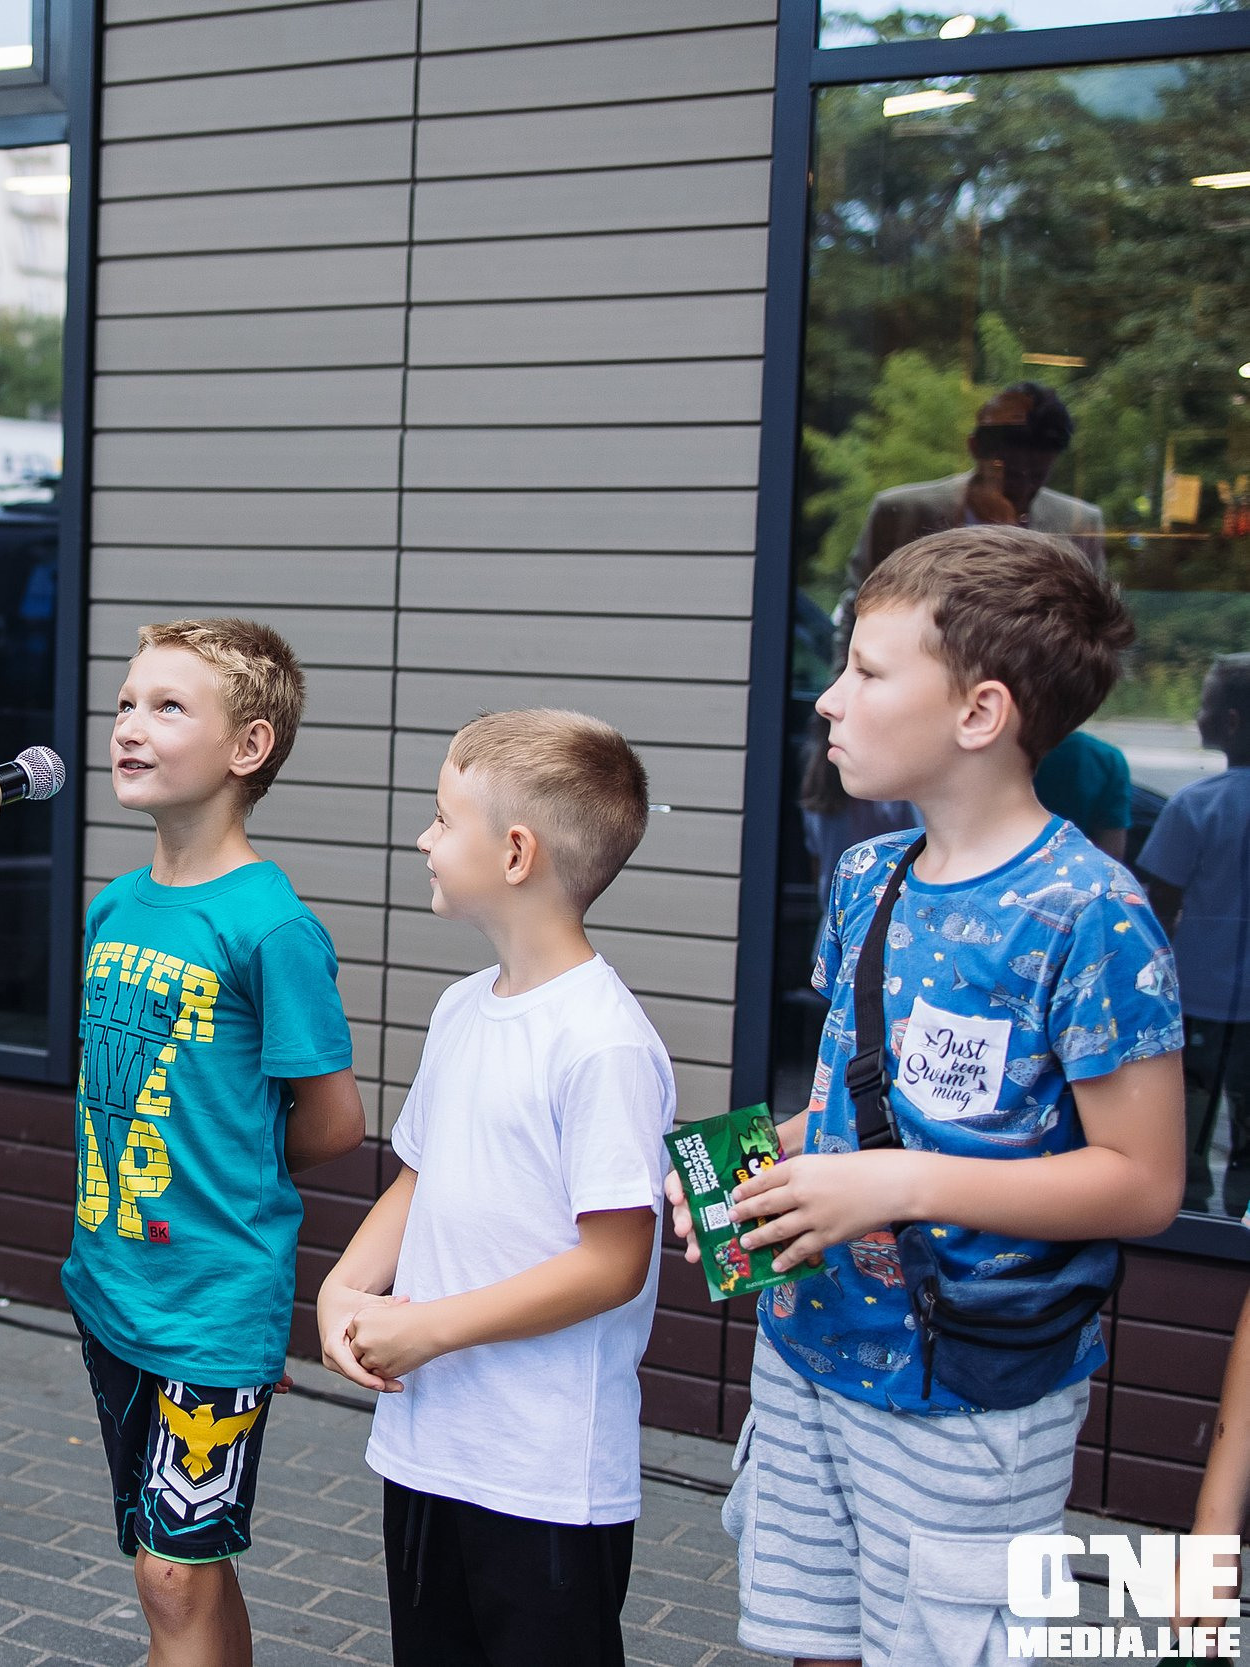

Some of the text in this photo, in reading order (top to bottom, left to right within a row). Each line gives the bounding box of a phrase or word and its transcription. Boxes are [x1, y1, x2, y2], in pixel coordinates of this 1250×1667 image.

[936, 1028, 990, 1060] Just
[903, 1052, 968, 1086] Swim
[950, 1057, 988, 1080] keep
[931, 1085, 973, 1113] ming
[682, 1136, 694, 1150] ЗА
[688, 1149, 711, 1193] КАЖДЫЕ
[682, 1160, 692, 1169] В
[687, 1168, 703, 1196] ЧЕКЕ
[691, 1133, 720, 1190] ПОДАРОК
[149, 1226, 168, 1240] BK
